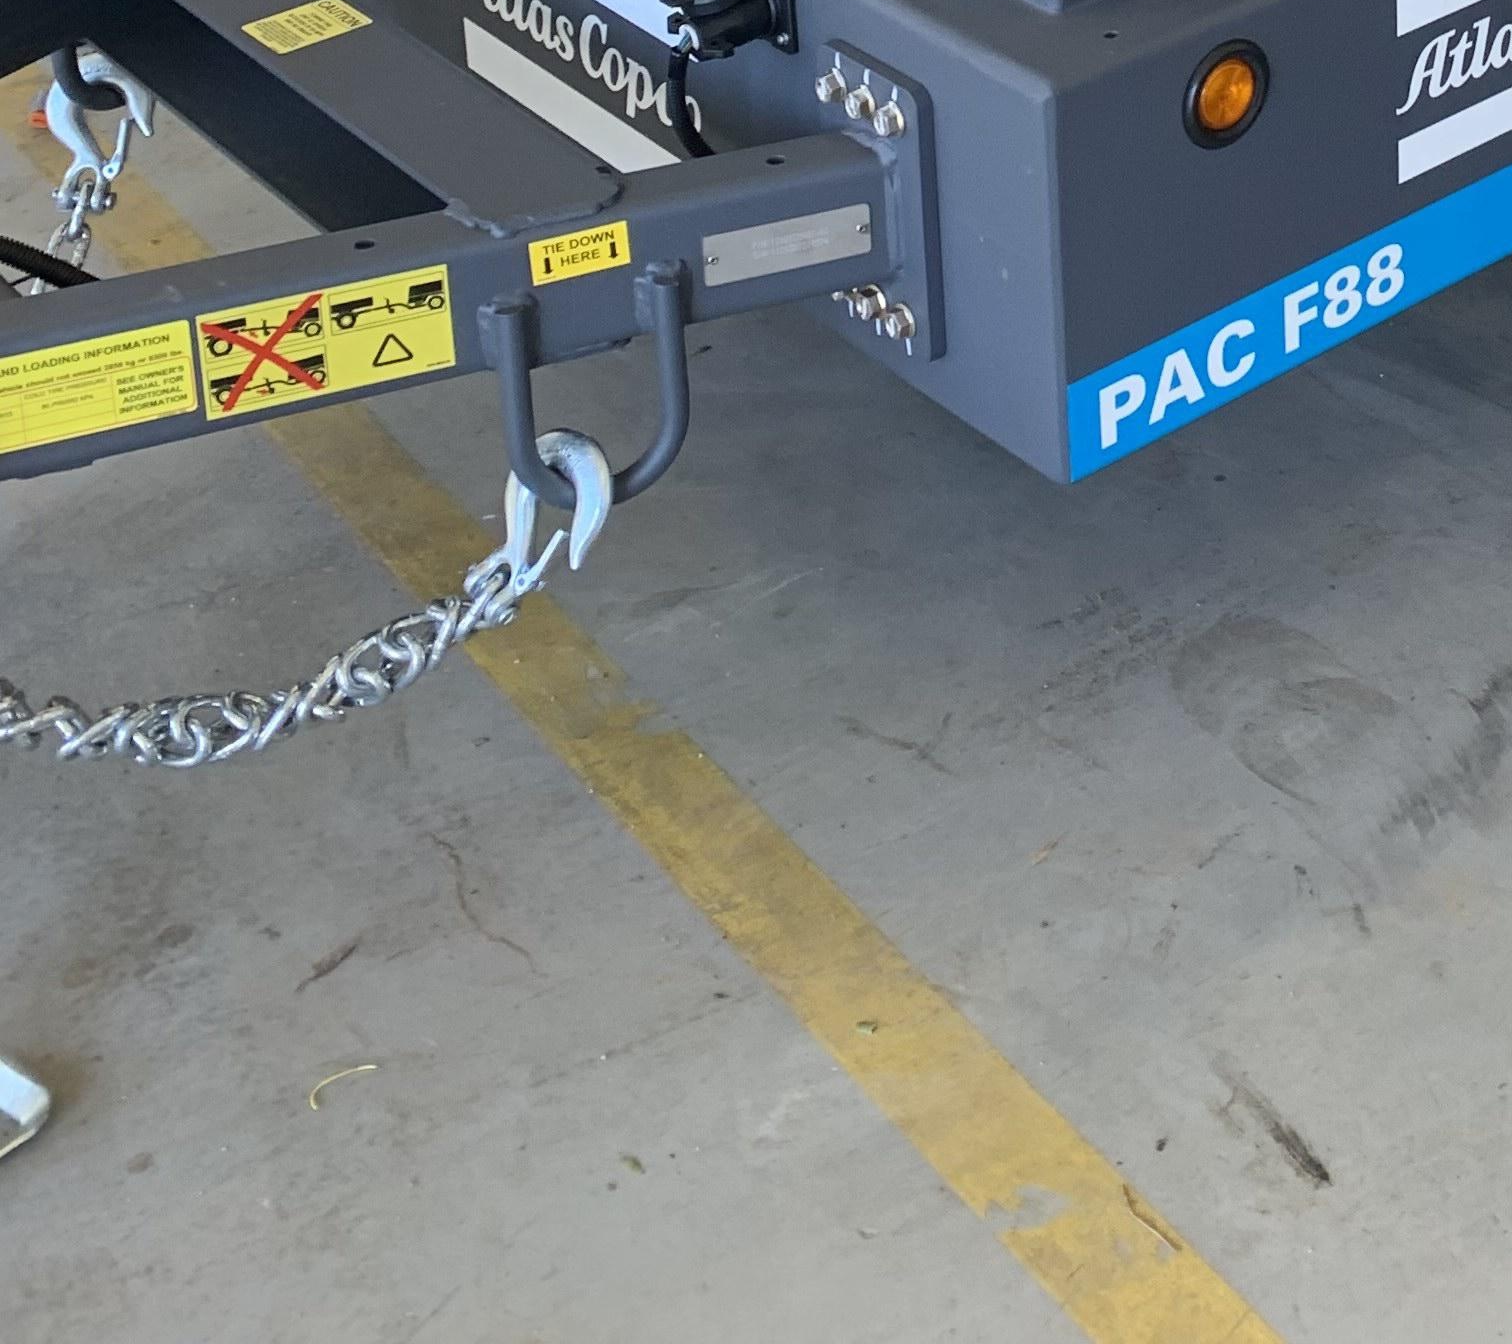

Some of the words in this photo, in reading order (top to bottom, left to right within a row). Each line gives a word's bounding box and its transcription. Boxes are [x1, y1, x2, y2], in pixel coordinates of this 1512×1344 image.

[542, 241, 565, 255] TIE
[569, 229, 615, 249] DOWN
[560, 248, 601, 267] HERE
[23, 353, 80, 373] LOADING
[84, 334, 170, 359] INFORMATION
[1099, 318, 1256, 450] PAC
[1284, 243, 1405, 354] F88
[163, 375, 184, 385] FOR
